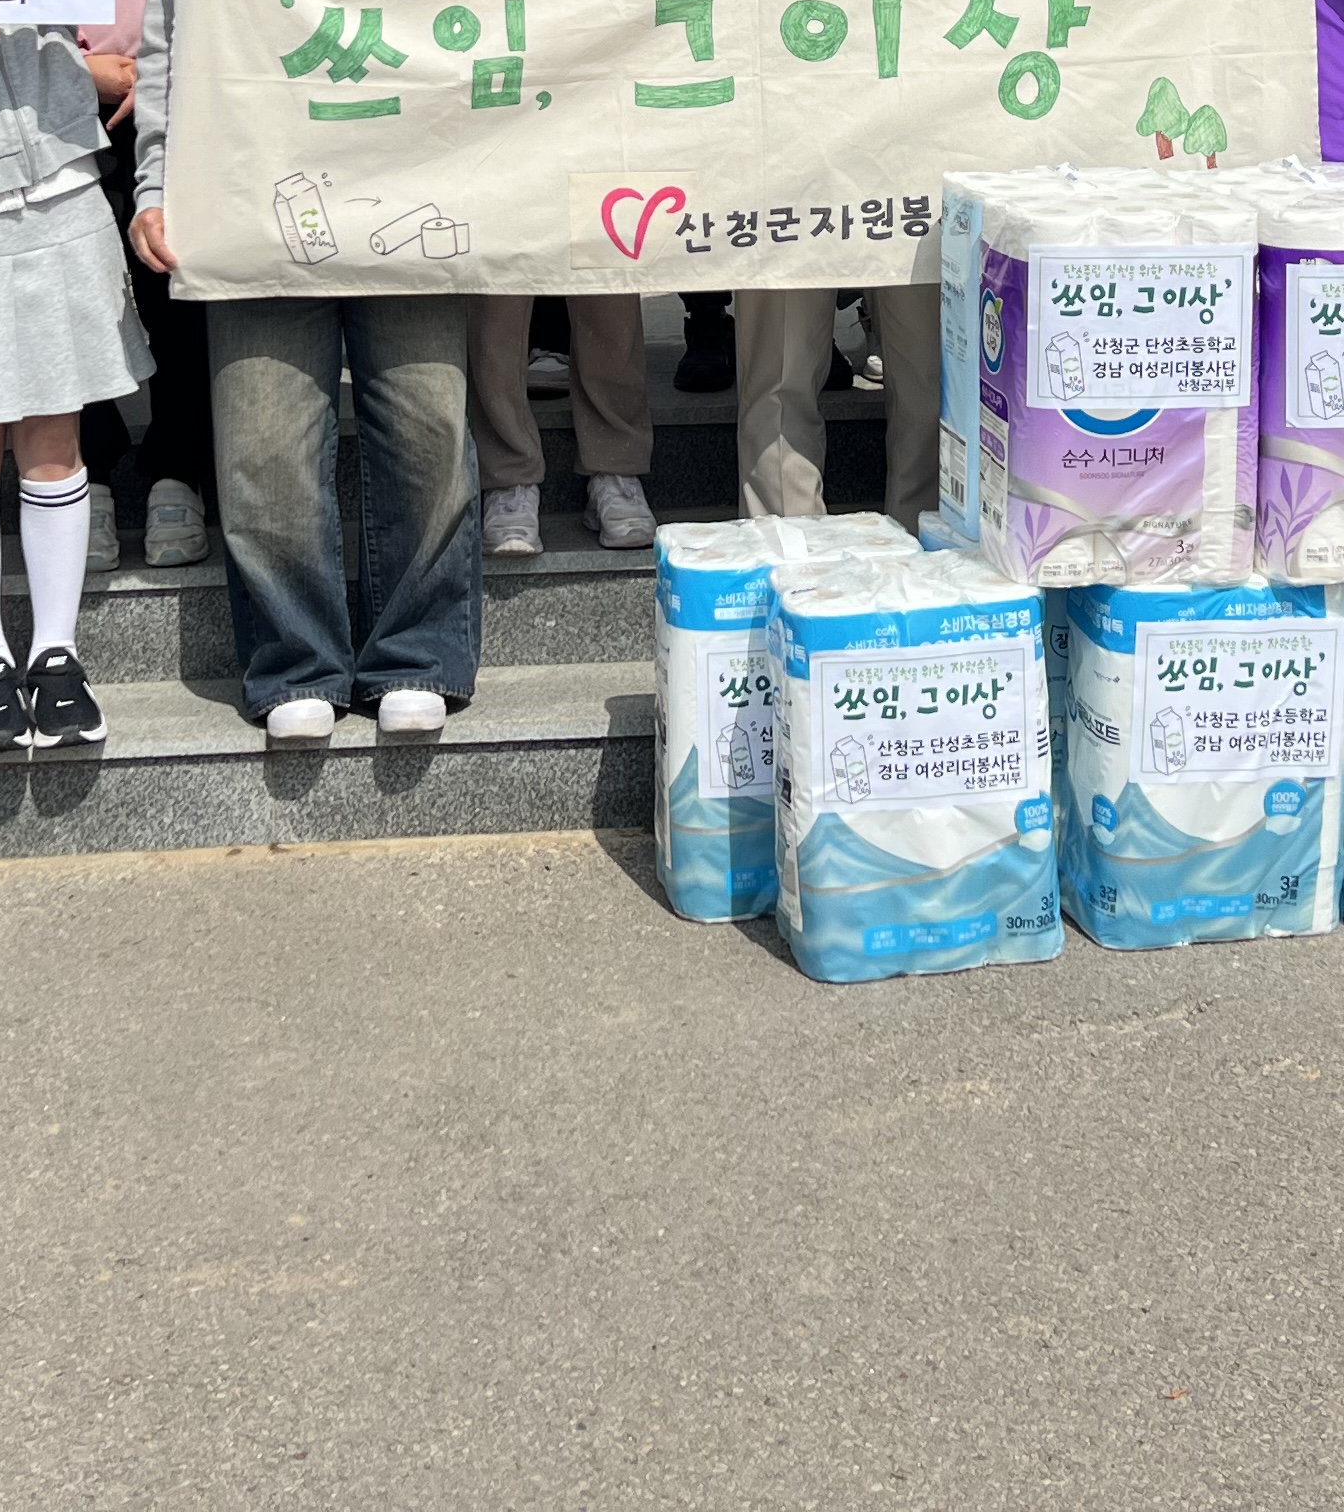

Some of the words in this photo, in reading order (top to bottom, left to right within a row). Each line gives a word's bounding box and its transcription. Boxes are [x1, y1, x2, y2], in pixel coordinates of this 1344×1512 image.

[675, 195, 932, 253] 산청군자원봉
[1063, 265, 1100, 281] 탄소중립
[1106, 264, 1135, 281] 실천을
[1139, 265, 1163, 280] 위한
[1169, 262, 1218, 278] 자원순환
[1093, 339, 1140, 355] 산청군
[1146, 337, 1236, 354] 단성초등학교
[1093, 363, 1123, 379] 경남
[1129, 360, 1236, 378] 여성리더봉사단
[1177, 379, 1235, 392] 산청군지부
[1062, 449, 1094, 468] 순수
[1099, 447, 1165, 467] 시그니처
[1143, 519, 1193, 529] SIGNATURE
[716, 592, 767, 606] 소비자중심
[939, 609, 1031, 635] 소비자중심경영
[1170, 640, 1203, 656] 탄소중립
[1208, 640, 1236, 656] 실천을
[1241, 639, 1263, 654] 위한
[1268, 636, 1312, 651] 자원순환
[845, 666, 883, 683] 탄소중립
[888, 666, 918, 683] 실천을
[922, 664, 944, 678] 위한
[950, 657, 998, 674] 자원순환
[1194, 712, 1239, 728] 산청군
[1245, 708, 1327, 727] 단성초등학교
[877, 740, 924, 757] 산청군
[930, 730, 1020, 753] 단성초등학교
[1194, 736, 1223, 752] 경남
[1229, 732, 1326, 752] 여성리더봉사단
[1270, 749, 1324, 762] 산청군지부
[878, 764, 909, 780] 경남
[915, 754, 1021, 778] 여성리더봉사단
[964, 774, 1022, 788] 산청군지부
[1272, 792, 1300, 803] 100%
[1023, 803, 1049, 818] 100%
